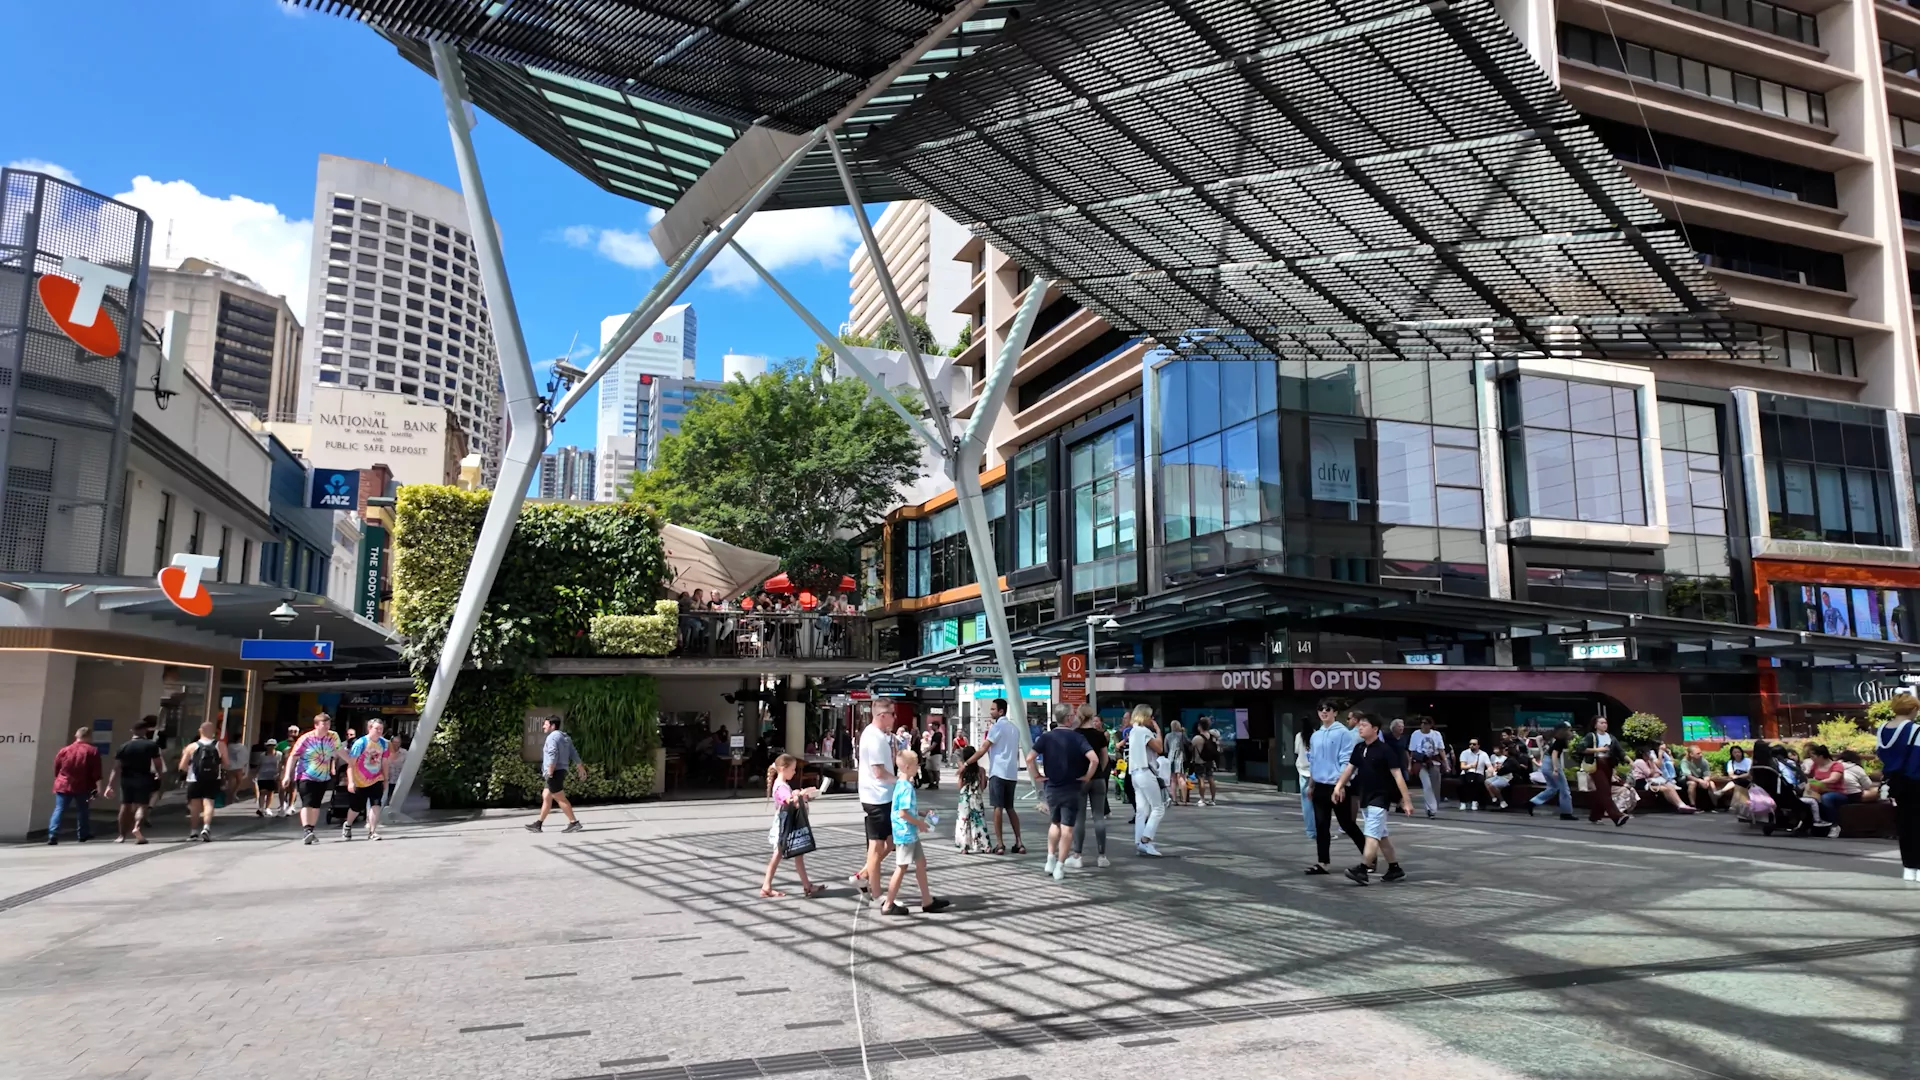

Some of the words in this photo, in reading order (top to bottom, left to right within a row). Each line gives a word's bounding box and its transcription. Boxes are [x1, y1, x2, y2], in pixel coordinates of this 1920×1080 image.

[664, 335, 678, 343] JLL
[320, 414, 389, 429] NATIONAL
[404, 420, 438, 432] BANK
[325, 440, 359, 450] PUBLIC
[364, 444, 385, 452] SAFE
[390, 445, 428, 455] DEPOSIT
[320, 495, 351, 506] ANZ
[369, 547, 379, 566] THE
[367, 570, 377, 598] BODY
[366, 600, 376, 622] SHO
[1271, 641, 1282, 654] 141
[1298, 641, 1312, 653] 141
[1579, 645, 1618, 655] OPTUS
[1221, 671, 1272, 689] OPTUS
[1310, 671, 1381, 690] OPTUS
[19, 732, 36, 743] in.
